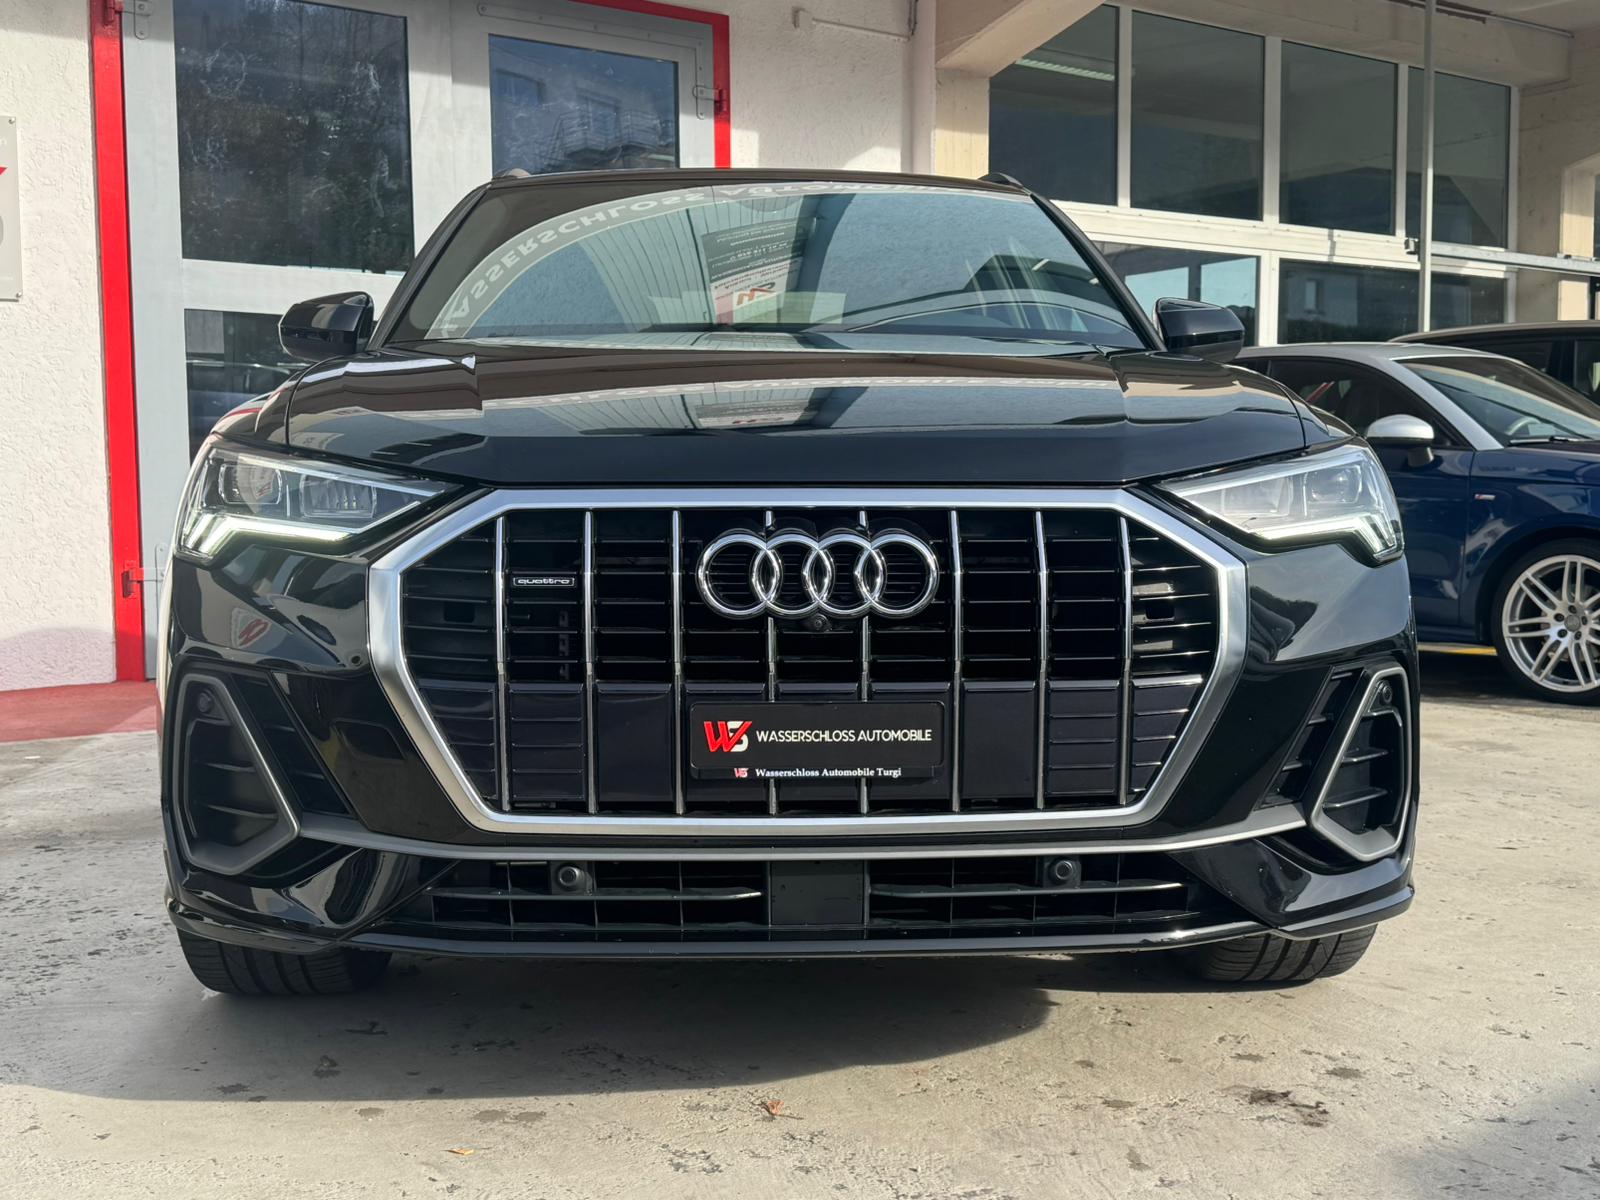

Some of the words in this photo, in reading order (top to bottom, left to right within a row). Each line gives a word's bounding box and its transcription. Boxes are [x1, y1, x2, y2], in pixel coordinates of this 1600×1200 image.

[756, 730, 856, 743] WASSERSCHLOSS
[857, 729, 932, 742] AUTOMOBILE
[755, 768, 819, 777] Wasserschloss
[821, 767, 875, 777] Automobile
[876, 767, 902, 779] Turgi
